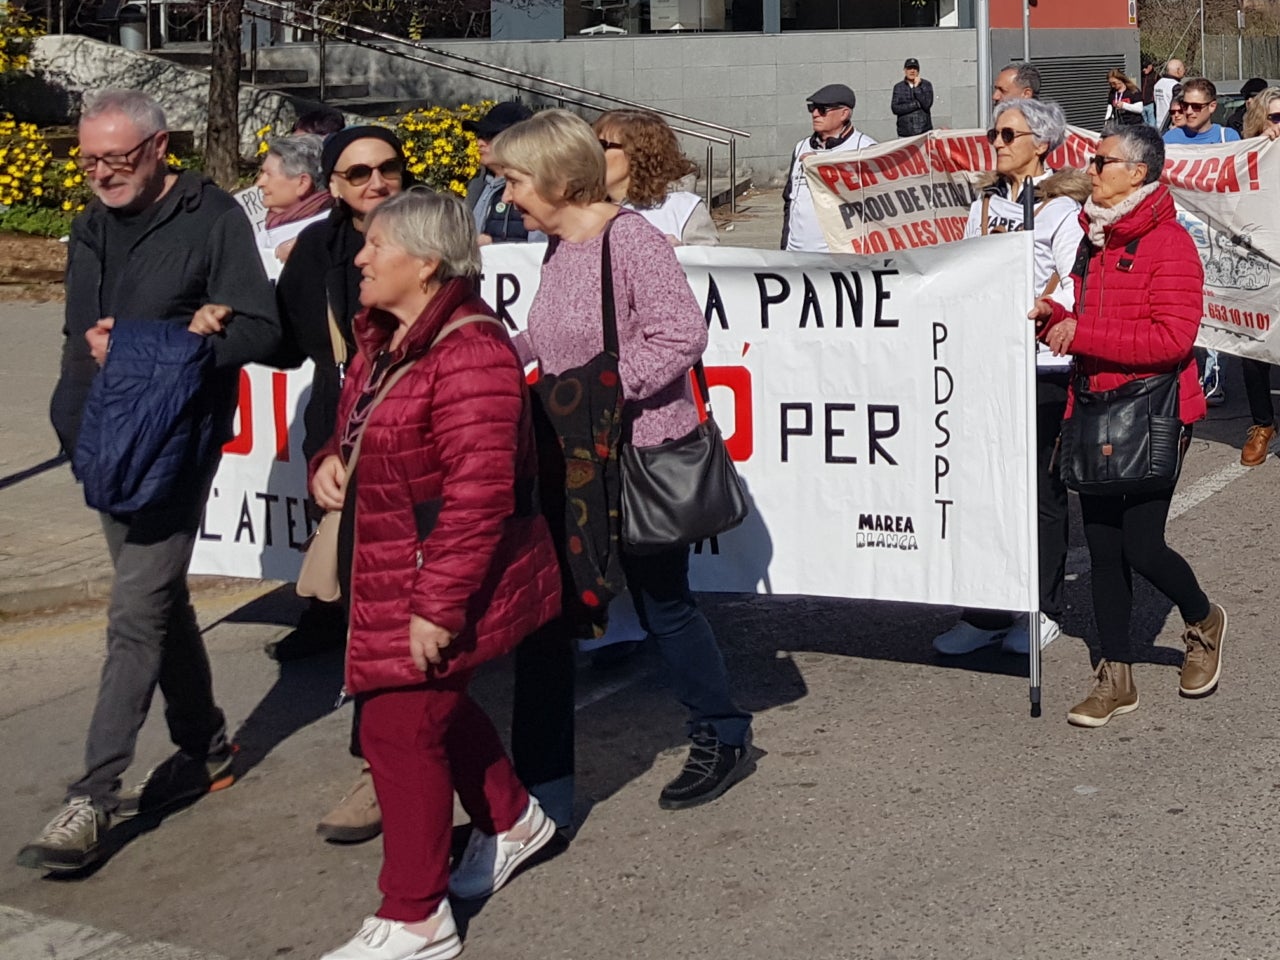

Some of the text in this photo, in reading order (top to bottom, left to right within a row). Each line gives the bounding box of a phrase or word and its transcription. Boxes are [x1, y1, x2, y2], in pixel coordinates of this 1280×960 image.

[816, 158, 879, 195] PER
[875, 143, 930, 182] UNA
[924, 135, 993, 173] SANIT
[1159, 154, 1240, 193] LICA
[838, 181, 978, 230] PROU DE RETAL
[902, 219, 939, 250] LES
[933, 216, 969, 243] VISI
[754, 258, 900, 330] PANÉ
[1207, 302, 1270, 331] 653 10 11 01
[780, 402, 900, 466] PER
[856, 531, 918, 551] BLANCA
[858, 513, 915, 534] MAREA
